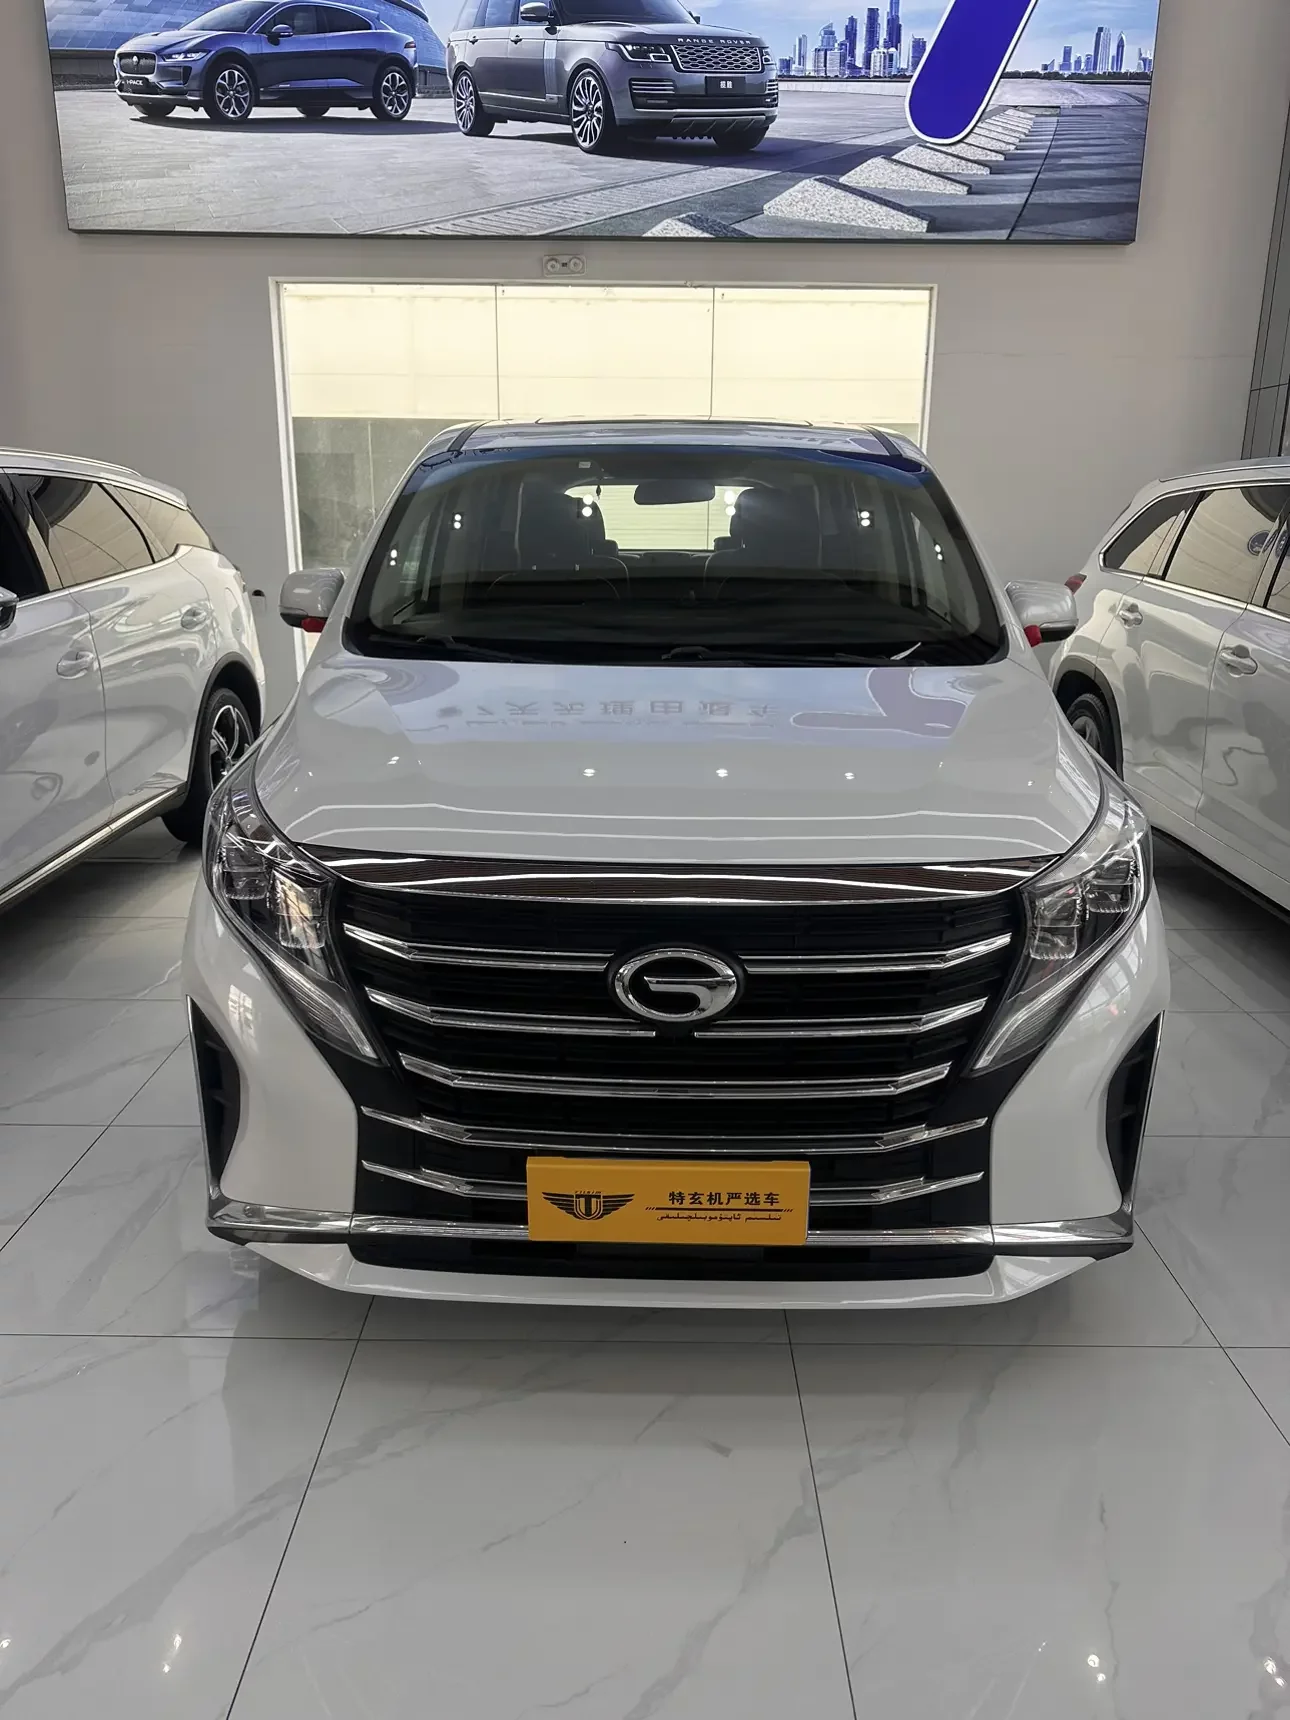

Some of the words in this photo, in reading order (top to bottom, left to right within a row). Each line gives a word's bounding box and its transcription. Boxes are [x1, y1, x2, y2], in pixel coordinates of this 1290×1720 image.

[668, 1190, 780, 1206] 特玄机严选车
